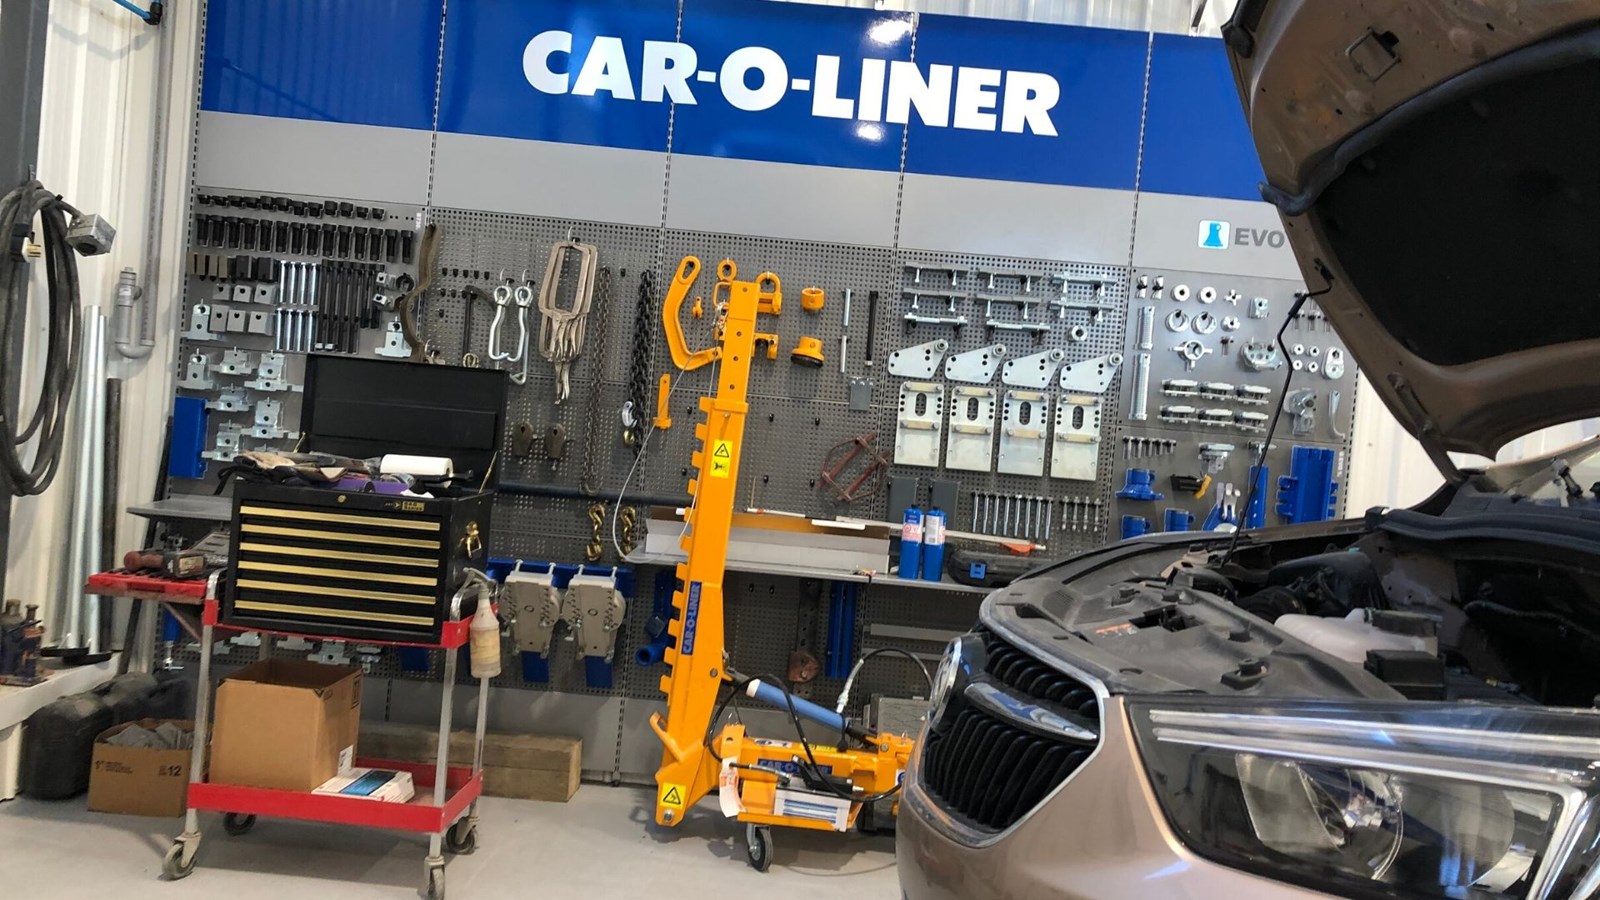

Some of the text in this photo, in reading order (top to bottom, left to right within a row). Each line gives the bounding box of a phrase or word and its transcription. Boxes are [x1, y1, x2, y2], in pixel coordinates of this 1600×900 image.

[522, 30, 1060, 137] CAR-O-LINER
[1234, 227, 1285, 248] EVO
[683, 583, 700, 654] CAR-O-LINER
